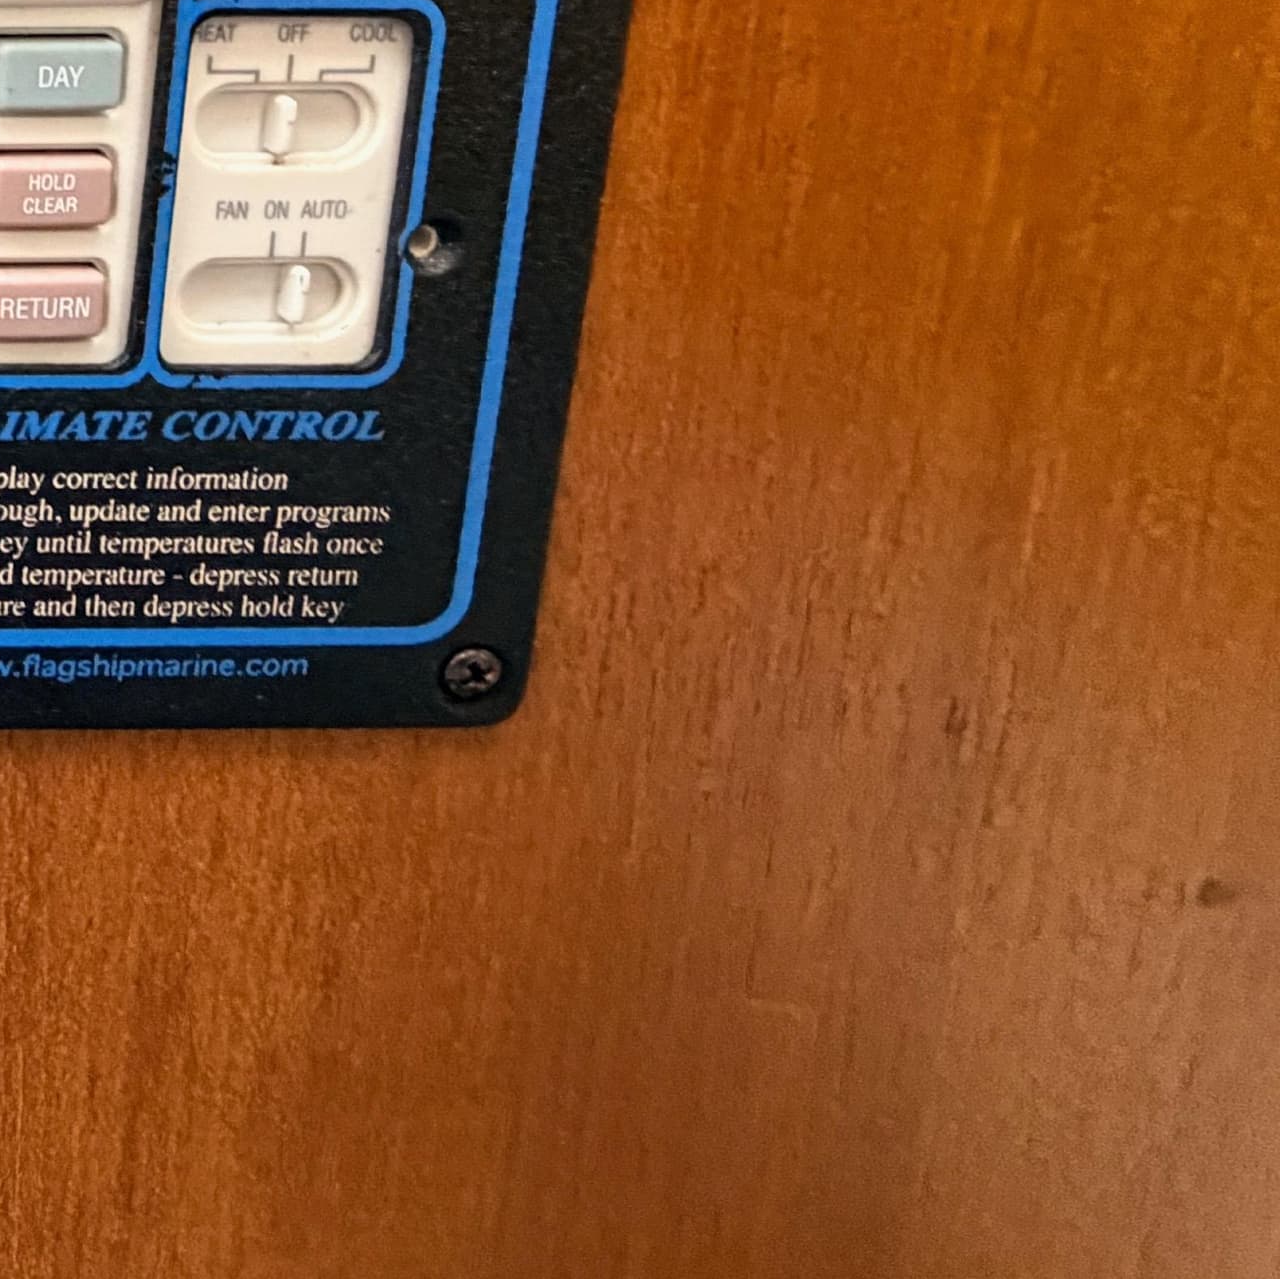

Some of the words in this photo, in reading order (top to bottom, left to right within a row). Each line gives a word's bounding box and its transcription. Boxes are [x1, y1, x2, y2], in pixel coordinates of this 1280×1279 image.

[278, 23, 310, 42] OFF
[350, 23, 398, 42] COOL
[38, 65, 84, 88] DAY
[29, 174, 75, 192] HOLD
[23, 196, 78, 215] CLEAR
[215, 199, 249, 220] FAN
[263, 199, 290, 220] ON
[300, 199, 348, 220] AUTO
[0, 296, 90, 319] RETURN
[161, 410, 385, 441] CONTROL
[52, 470, 138, 490] correct
[146, 466, 289, 490] information
[69, 498, 150, 527] update
[157, 499, 201, 522] and
[208, 503, 270, 522] enter
[276, 505, 391, 529] programs
[36, 531, 90, 553] until
[99, 534, 255, 560] temperatures
[262, 531, 318, 554] flash
[326, 537, 384, 554] once
[21, 566, 165, 591] temperature
[189, 563, 280, 592] depress
[288, 567, 358, 586] return
[33, 594, 76, 617] and
[85, 594, 135, 617] then
[143, 594, 233, 623] depress
[241, 595, 293, 617] hold
[301, 595, 344, 624] key
